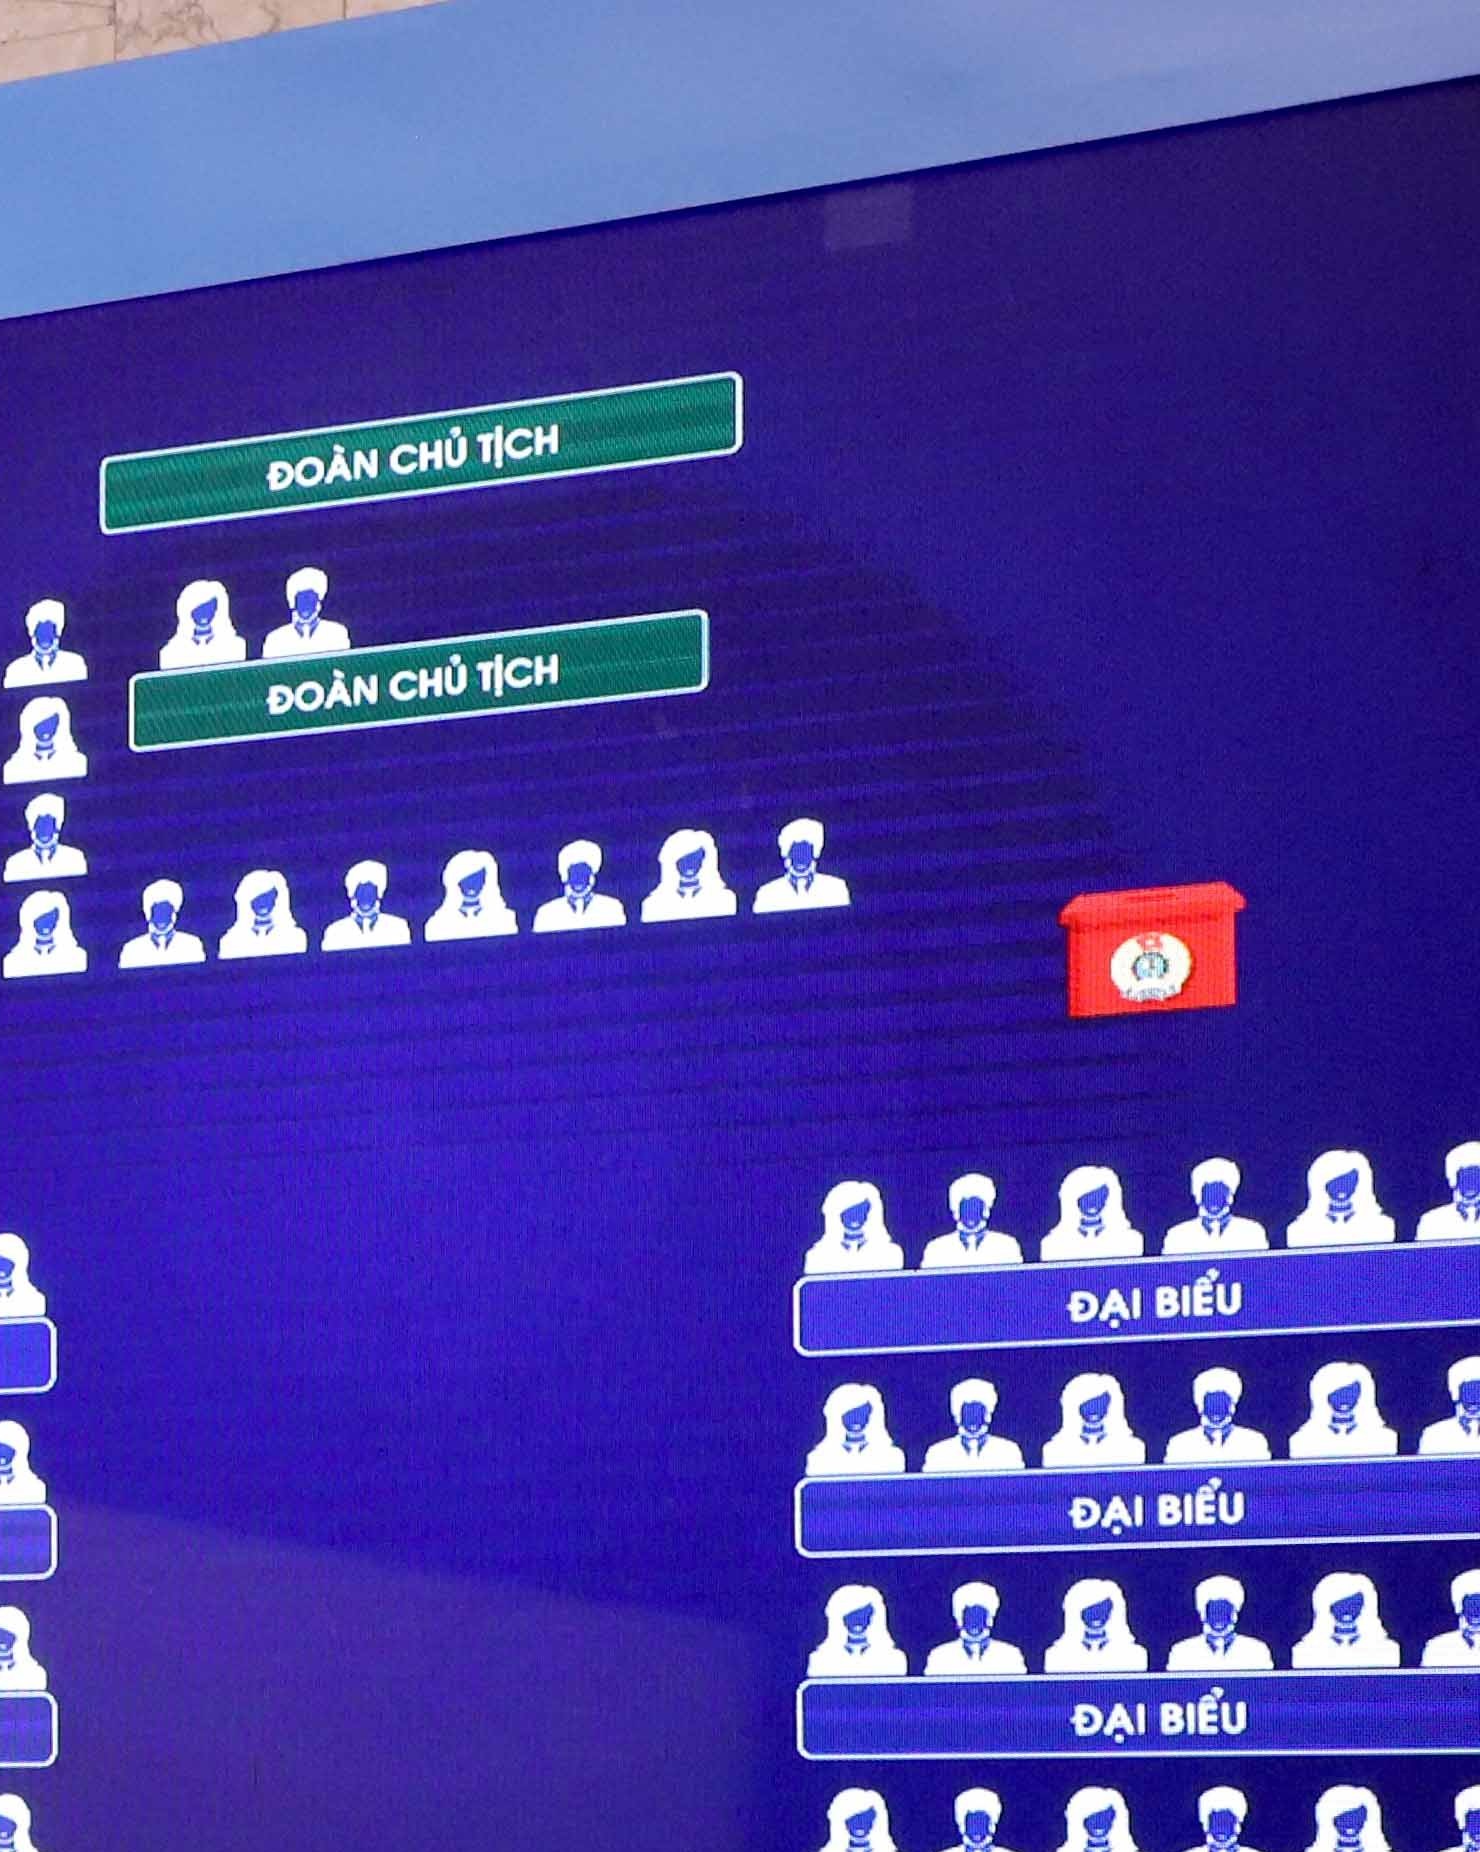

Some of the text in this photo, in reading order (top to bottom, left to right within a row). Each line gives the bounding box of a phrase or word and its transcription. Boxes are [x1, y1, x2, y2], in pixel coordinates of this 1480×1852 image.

[266, 424, 559, 491] ĐOÀN CHỦ TỊCH
[266, 653, 559, 715] ĐOÀN CHỦ TỊCH
[1067, 1268, 1244, 1328] ĐẠI BIỂU
[1069, 1477, 1246, 1535] ĐẠI BIỂU
[1070, 1686, 1248, 1743] ĐẠI BIỂU
